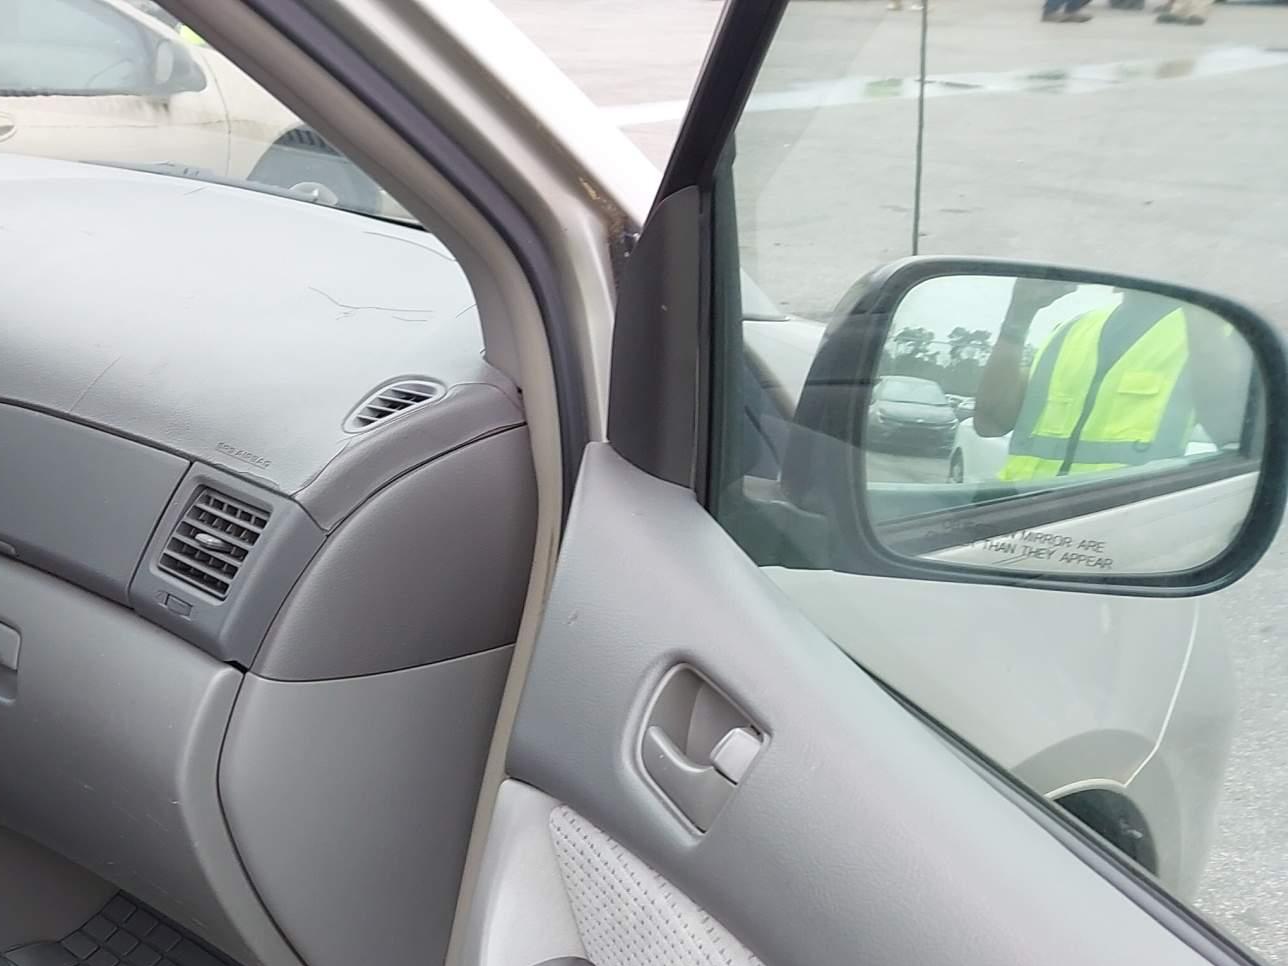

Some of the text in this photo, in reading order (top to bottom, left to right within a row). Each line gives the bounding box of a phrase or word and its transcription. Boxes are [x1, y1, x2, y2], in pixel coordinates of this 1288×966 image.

[1021, 530, 1072, 548] MIRROR
[1077, 540, 1105, 553] ARE
[1022, 545, 1056, 560] THEY
[1059, 552, 1113, 568] APPEAR
